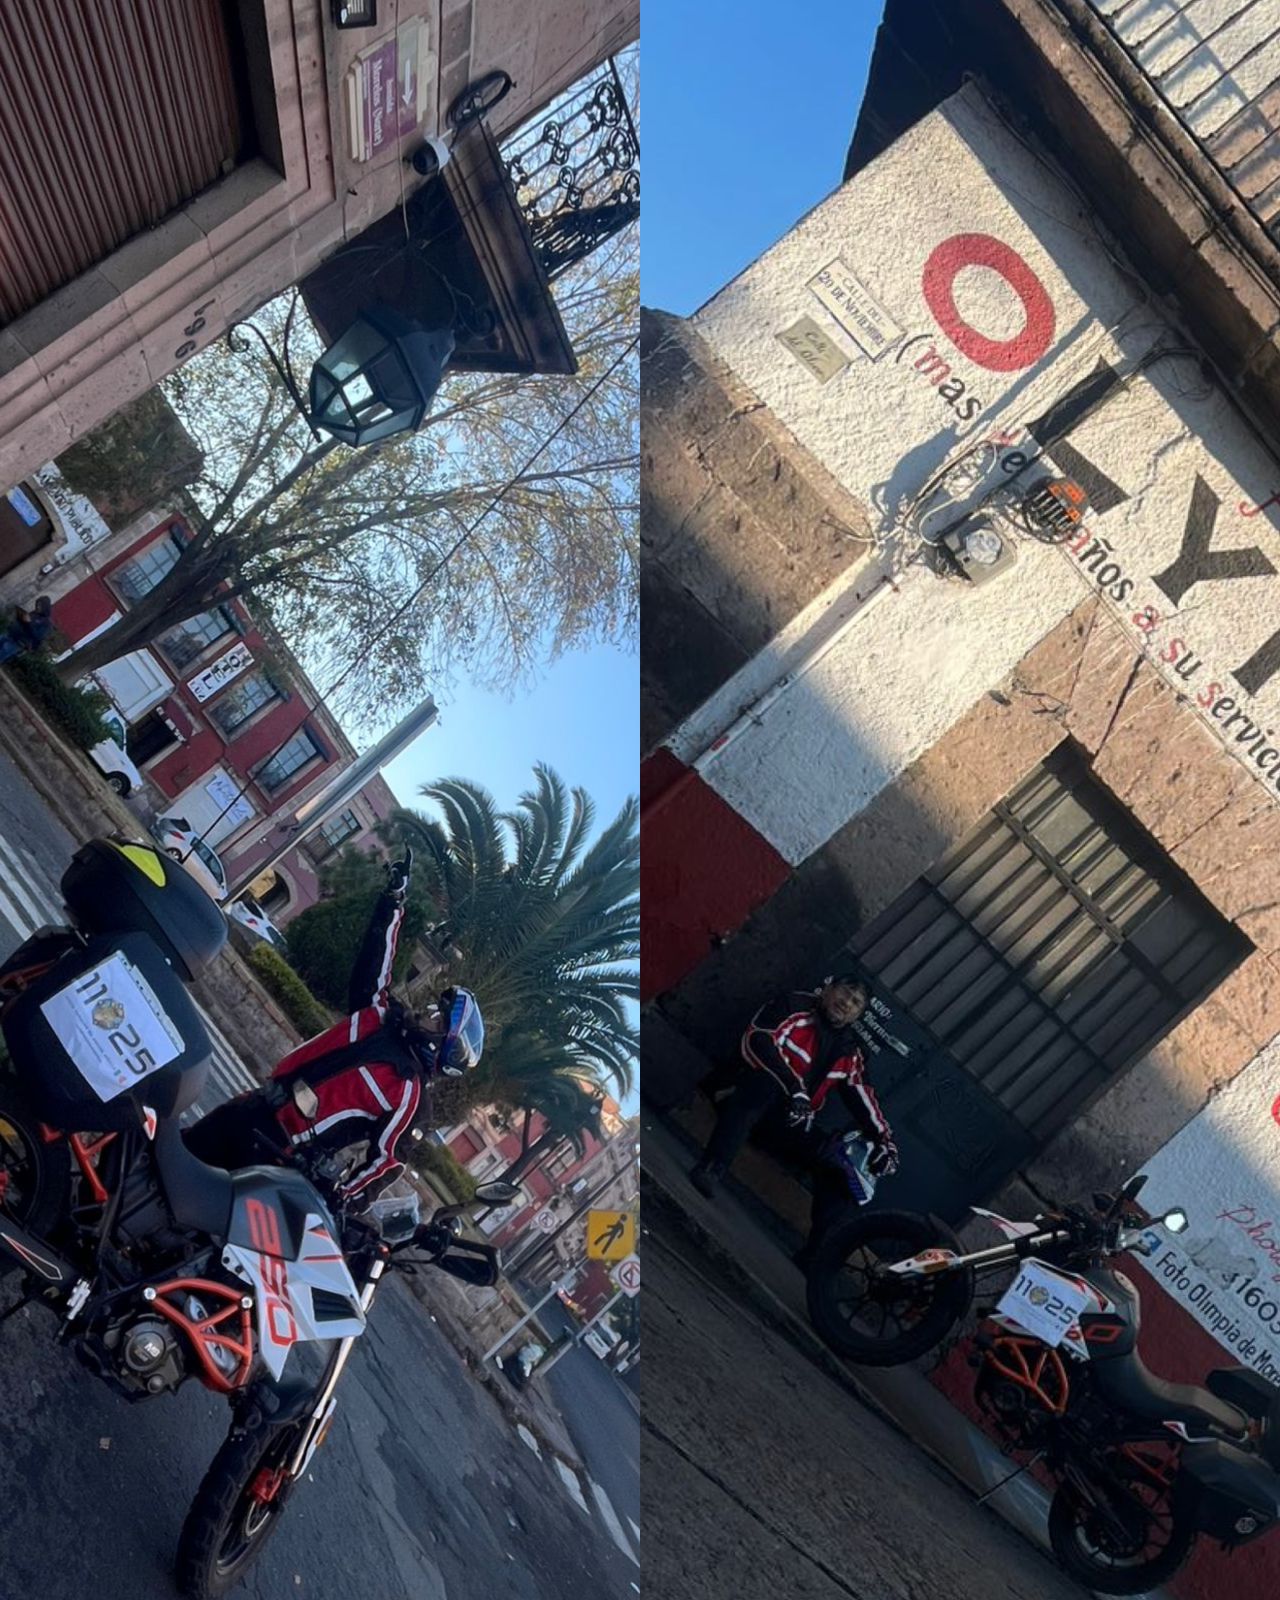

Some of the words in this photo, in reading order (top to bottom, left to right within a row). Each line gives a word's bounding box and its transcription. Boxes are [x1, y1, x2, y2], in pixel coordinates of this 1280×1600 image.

[818, 270, 836, 289] 20
[174, 297, 216, 359] 196
[1131, 604, 1161, 634] a
[1159, 636, 1204, 681] su
[1196, 681, 1280, 795] servici
[1155, 1250, 1191, 1292] Foto
[1237, 1337, 1257, 1361] de
